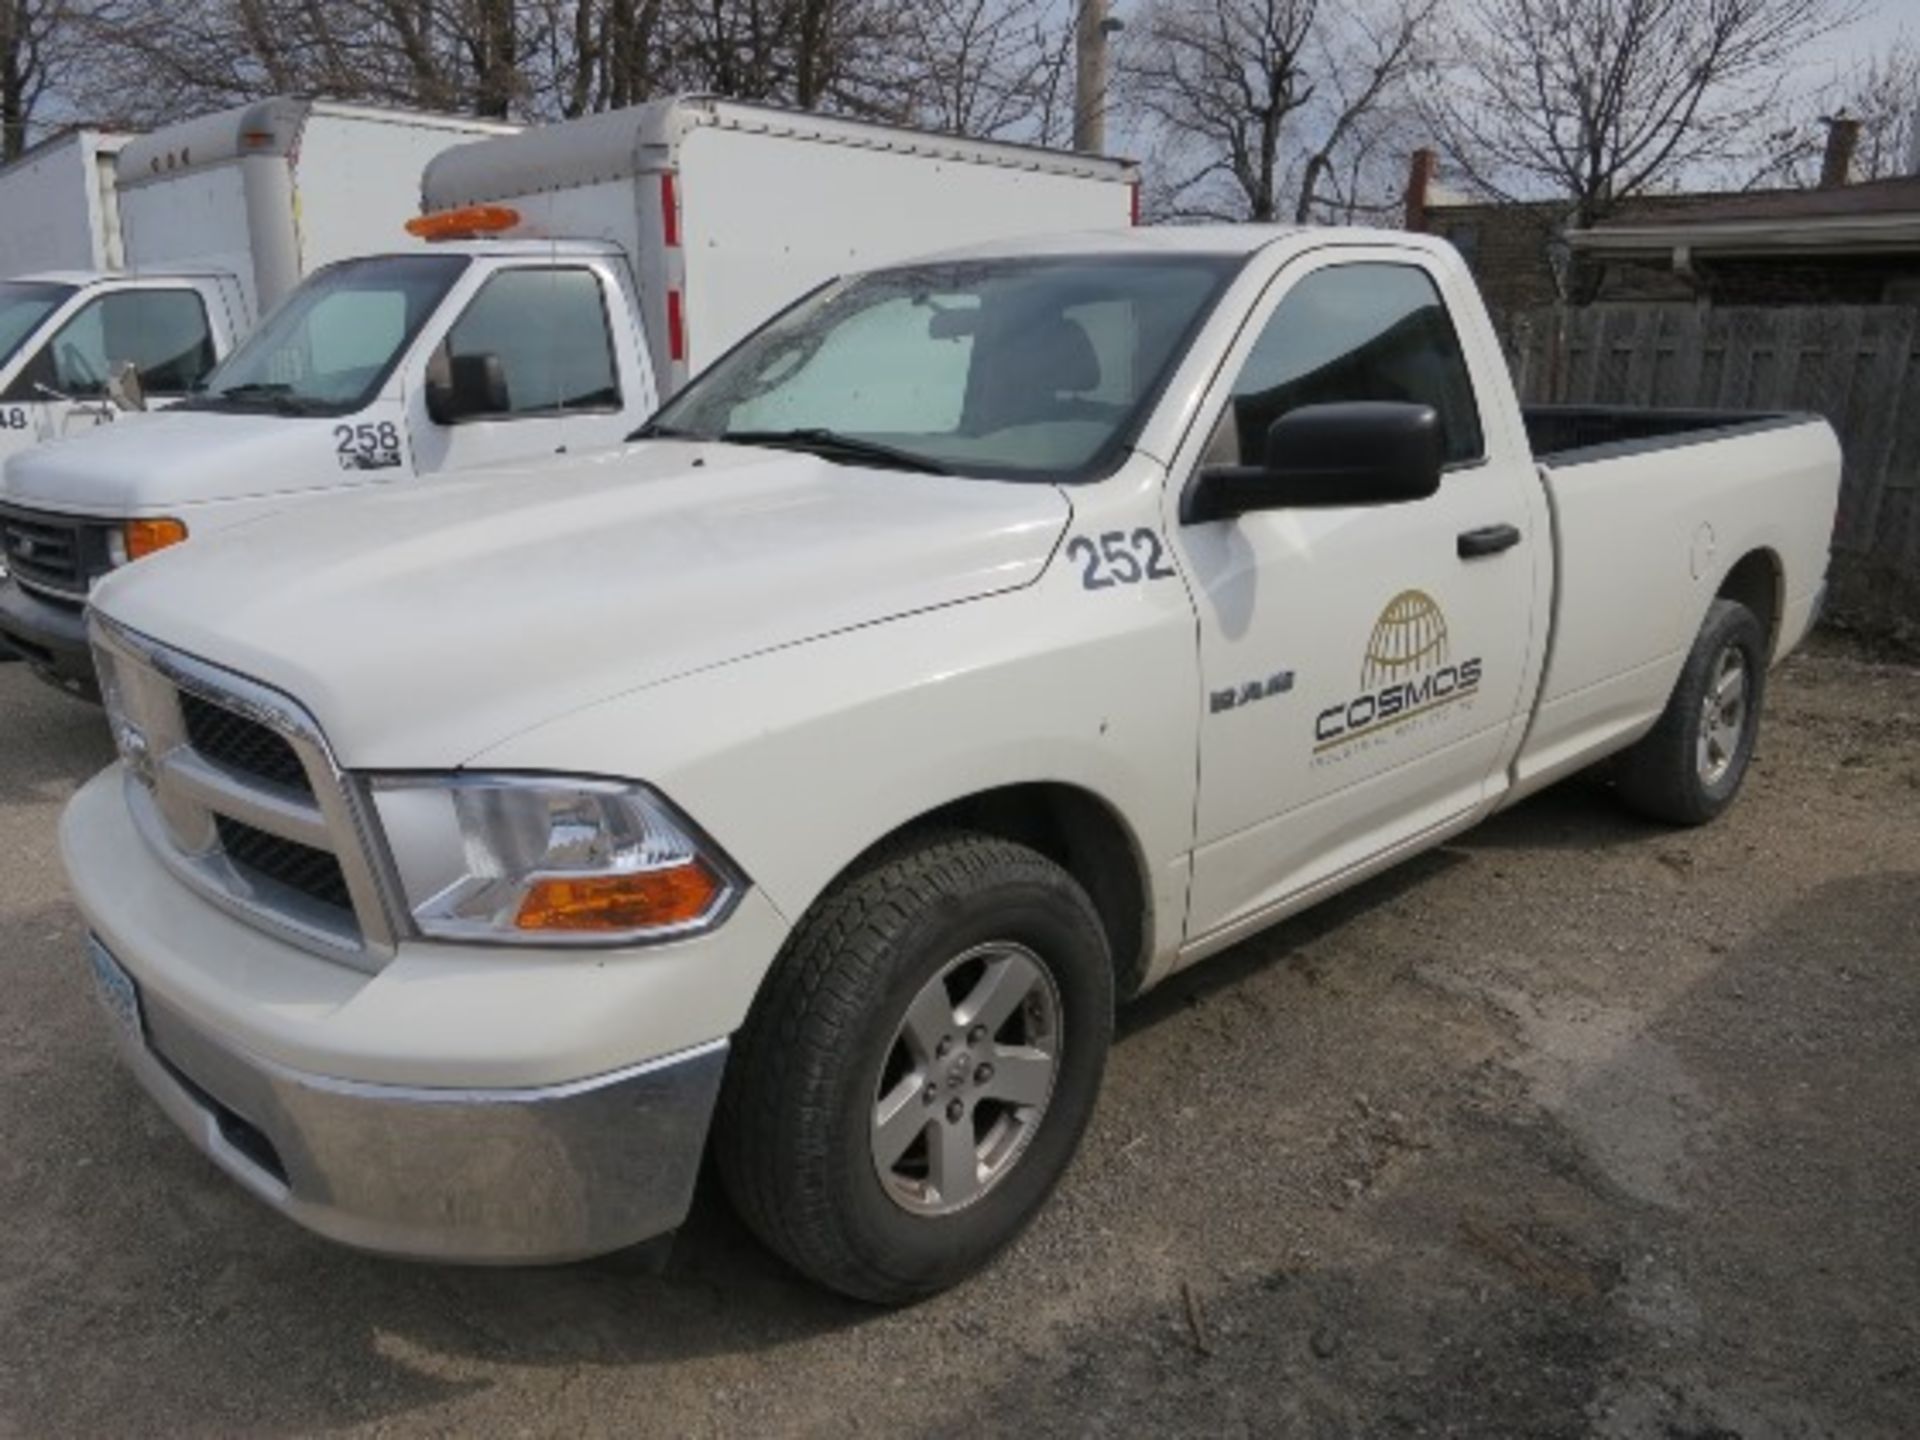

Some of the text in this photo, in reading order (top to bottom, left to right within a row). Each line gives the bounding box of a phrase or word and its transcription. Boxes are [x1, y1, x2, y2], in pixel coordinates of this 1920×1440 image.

[333, 421, 399, 453] 258
[1066, 527, 1176, 590] 252
[1315, 657, 1482, 741] COSMOS
